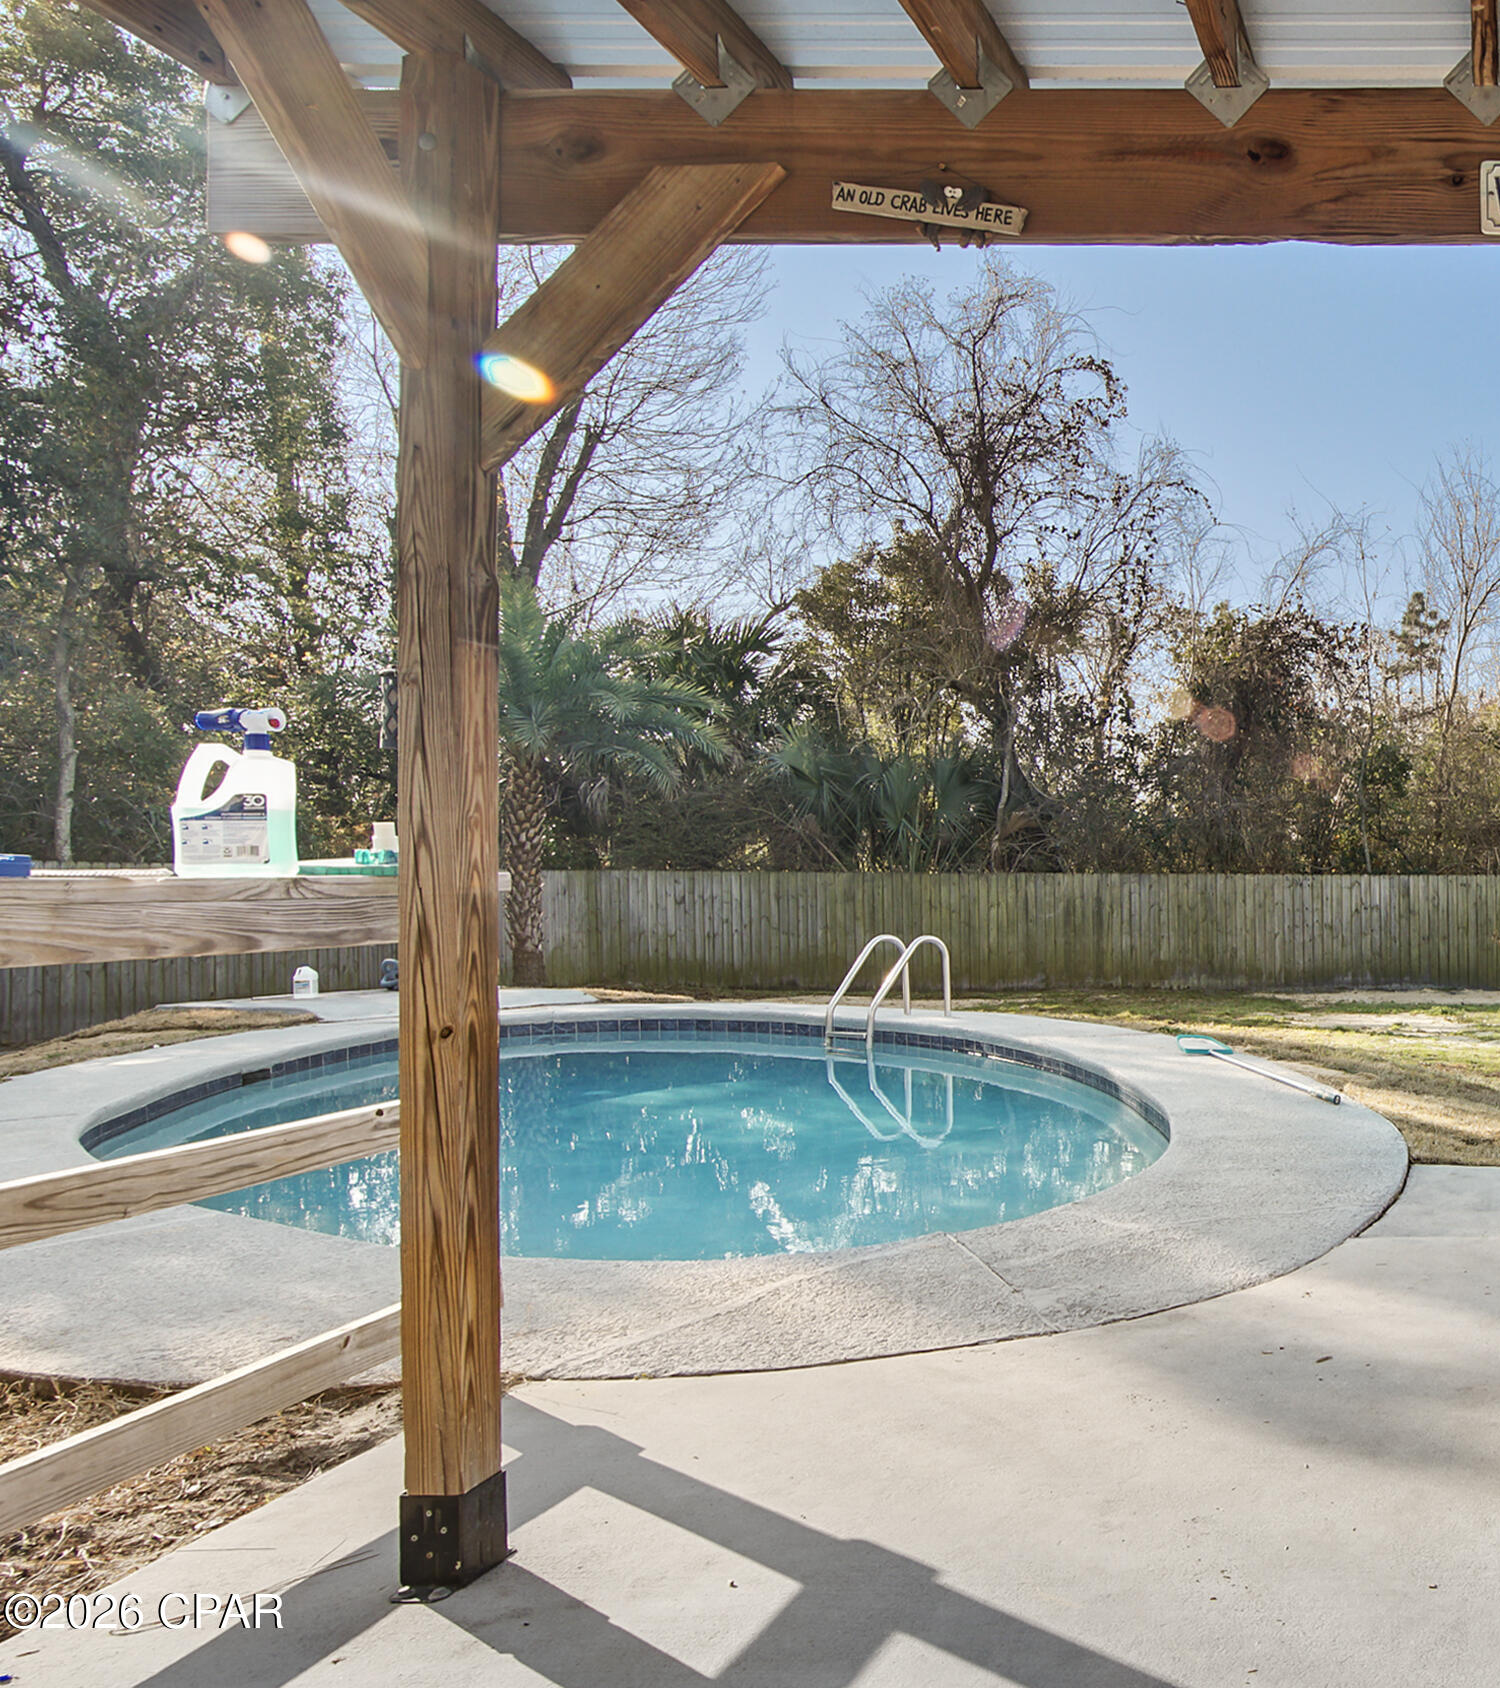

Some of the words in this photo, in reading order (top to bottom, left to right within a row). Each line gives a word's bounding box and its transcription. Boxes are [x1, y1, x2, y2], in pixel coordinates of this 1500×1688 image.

[835, 186, 856, 203] AN
[858, 190, 885, 206] OLD
[890, 194, 927, 213] CRAB
[932, 199, 969, 219] LIVES
[974, 206, 1013, 225] HERE
